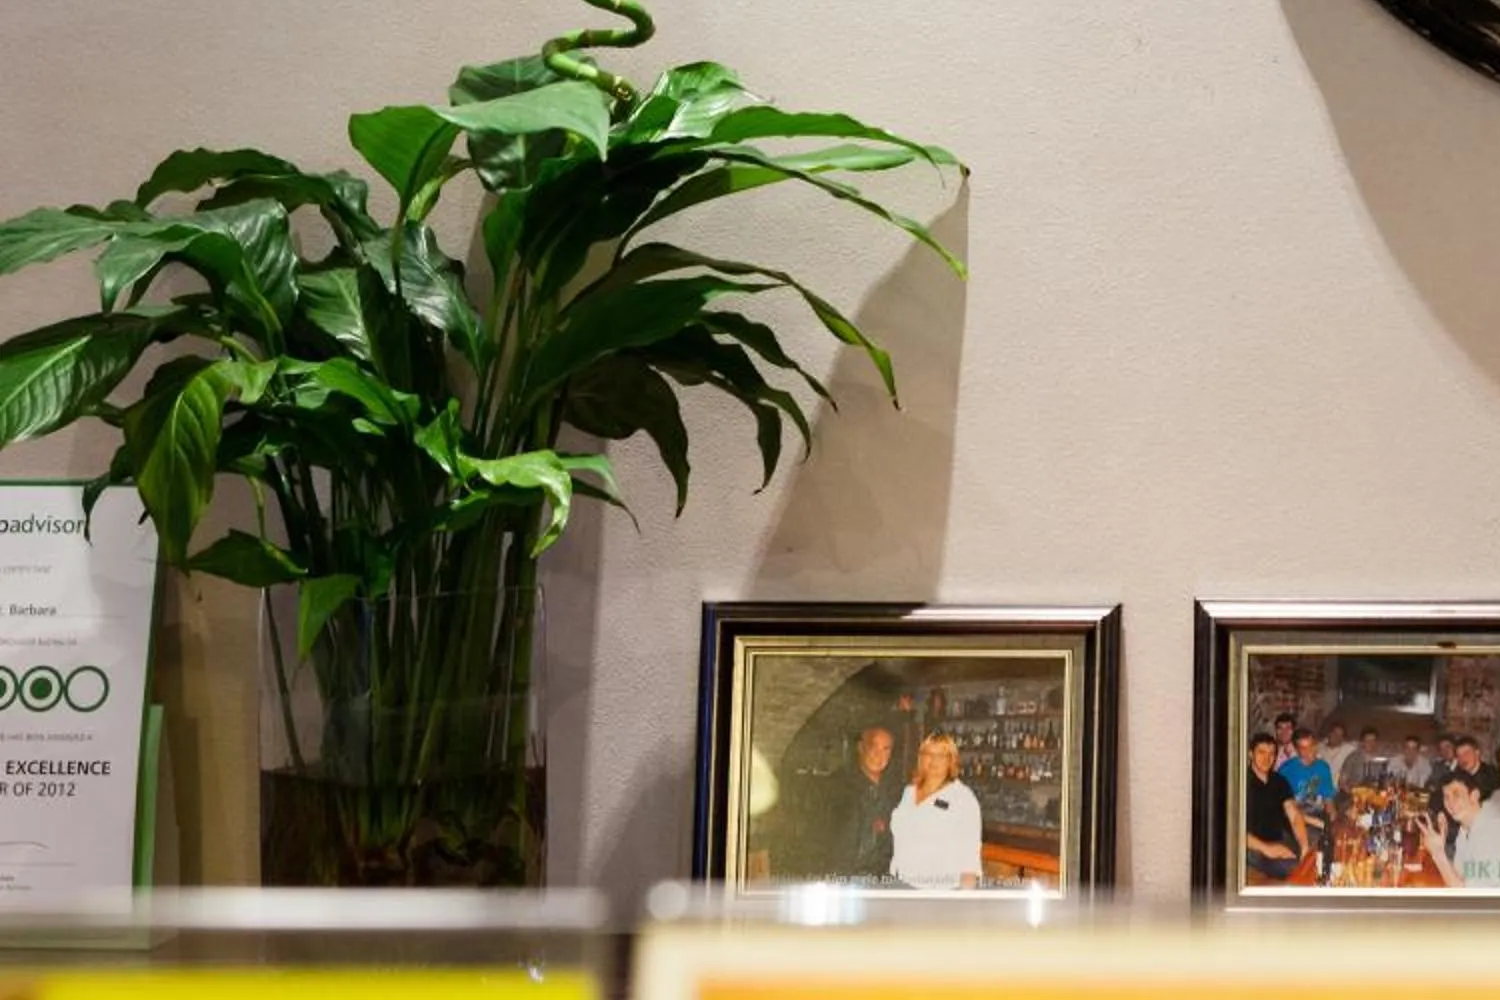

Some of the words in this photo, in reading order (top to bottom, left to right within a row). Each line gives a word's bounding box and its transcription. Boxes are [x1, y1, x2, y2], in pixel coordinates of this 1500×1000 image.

[5, 760, 112, 775] EXCELLENCE
[13, 782, 34, 796] OF
[38, 782, 77, 797] 2012
